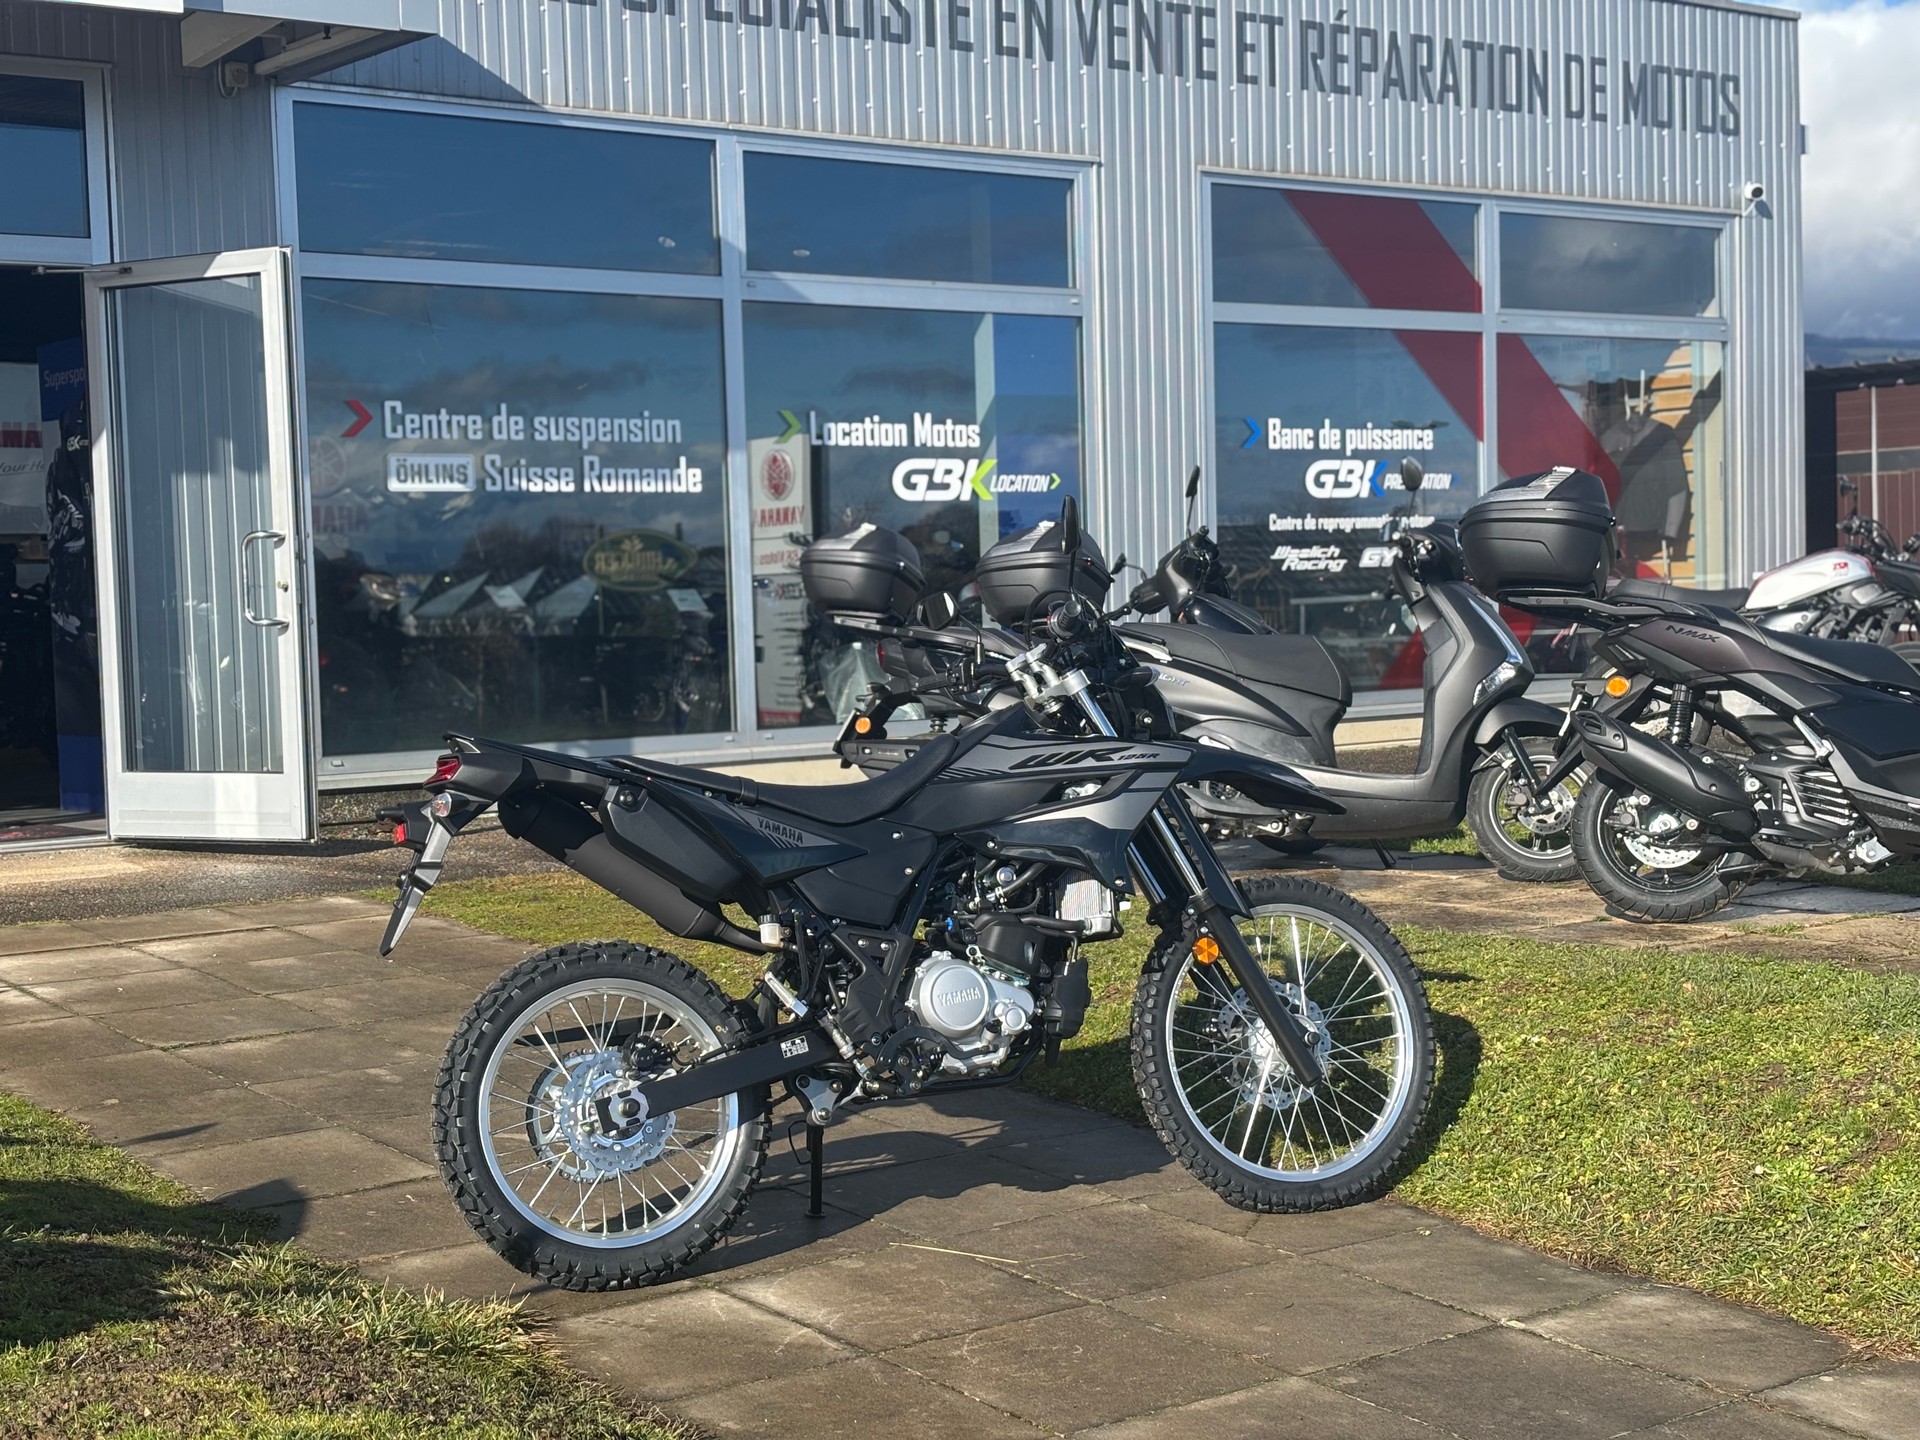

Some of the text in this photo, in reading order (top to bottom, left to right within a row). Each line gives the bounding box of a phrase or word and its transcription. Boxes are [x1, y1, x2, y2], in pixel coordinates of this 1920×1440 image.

[995, 0, 1054, 62] EN
[1076, 0, 1217, 81] VENTE
[1236, 11, 1284, 87] ET
[1300, 9, 1548, 117] RÉPARATION
[1565, 52, 1607, 123] DE
[1623, 60, 1741, 137] MOTOS
[43, 367, 85, 391] Superspo
[383, 400, 682, 449] Centre de suspension
[809, 410, 981, 448] Location Motos
[1267, 417, 1434, 457] Banc de puissance
[395, 458, 470, 485] ÖHLINS
[484, 454, 703, 494] Suisse Romande
[892, 457, 1050, 501] GBK LOCATION
[1304, 459, 1453, 499] GBK PREATION
[1268, 513, 1302, 532] Centre
[1304, 512, 1317, 531] de
[1318, 512, 1400, 535] reprogrammati
[1281, 557, 1348, 573] Racing
[1358, 546, 1398, 568] GY
[1664, 625, 1720, 643] NMAX
[1008, 745, 1161, 770] WR 125R
[757, 816, 803, 845] YAMAHA
[937, 986, 981, 1007] YAMAHA
